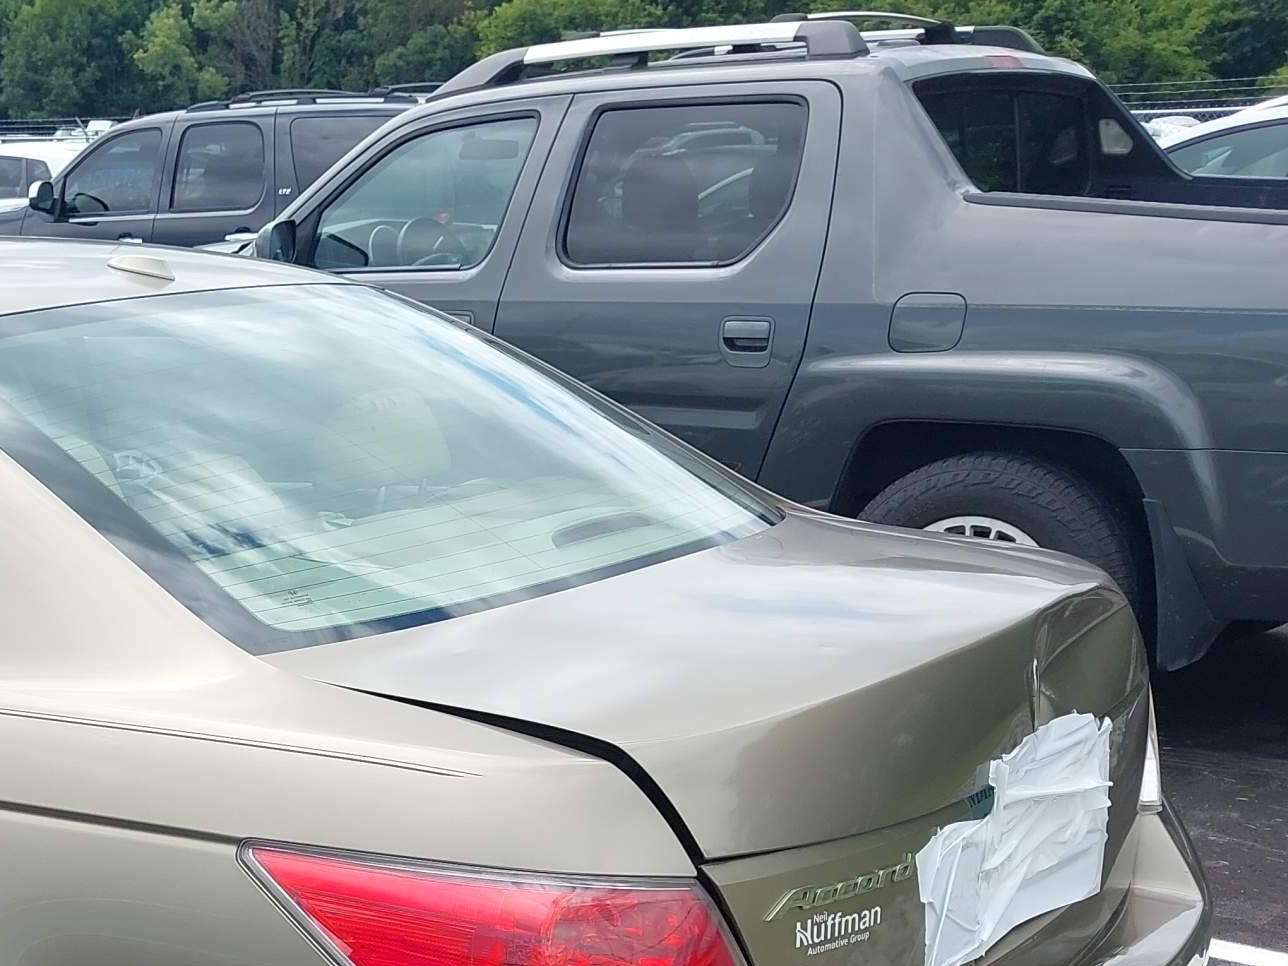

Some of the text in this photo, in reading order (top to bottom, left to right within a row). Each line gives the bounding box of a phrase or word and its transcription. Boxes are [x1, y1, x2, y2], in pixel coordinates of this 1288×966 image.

[762, 852, 913, 922] Accord
[795, 905, 882, 949] Huffman
[813, 911, 829, 924] Neil
[807, 931, 870, 956] Automotive Group
